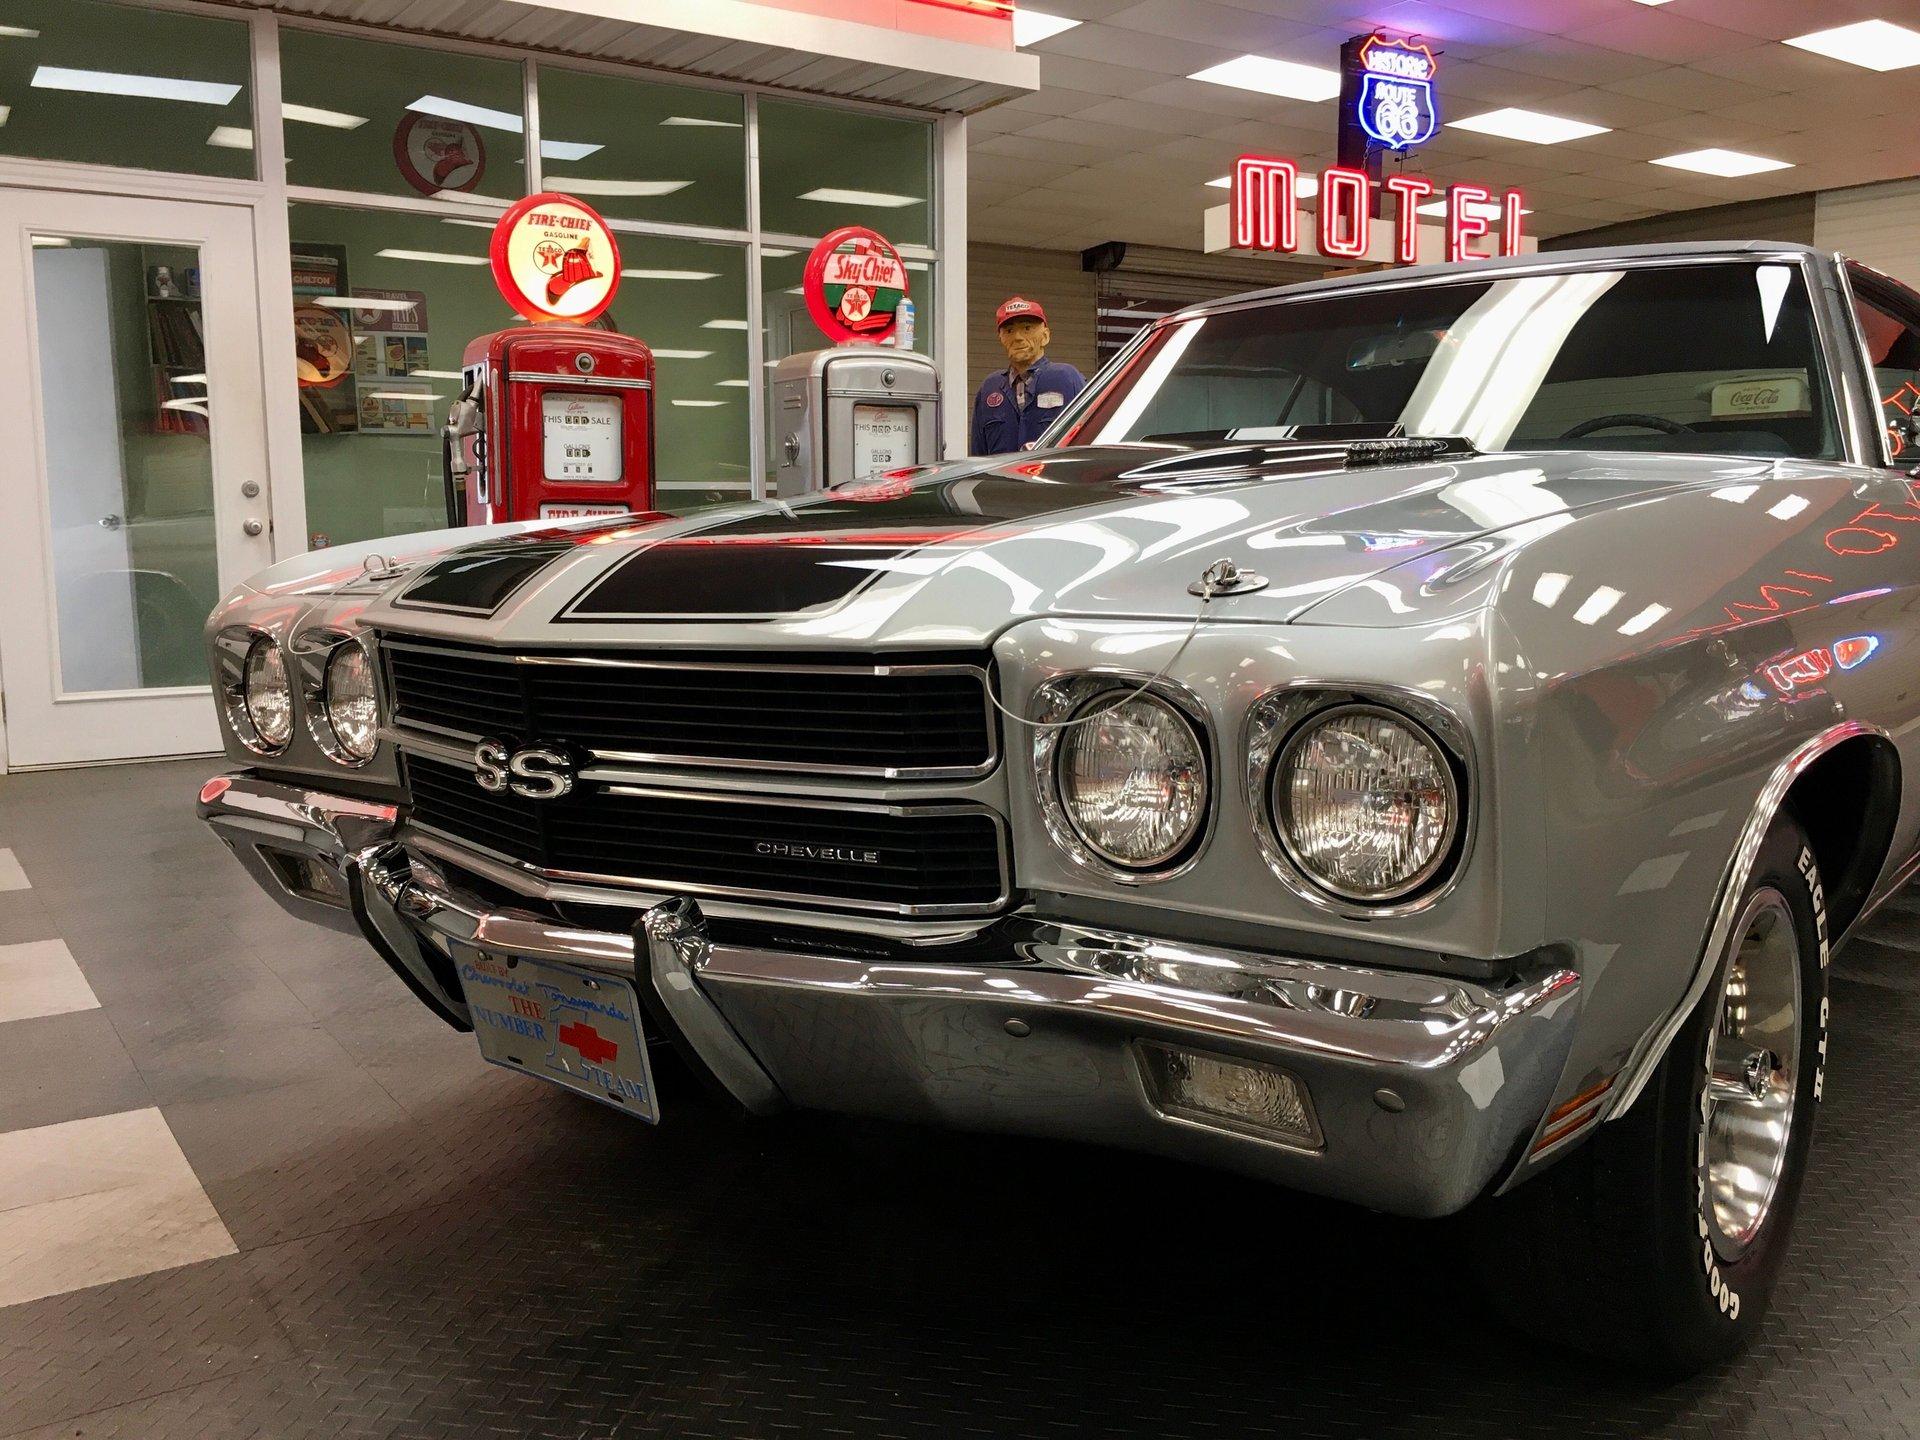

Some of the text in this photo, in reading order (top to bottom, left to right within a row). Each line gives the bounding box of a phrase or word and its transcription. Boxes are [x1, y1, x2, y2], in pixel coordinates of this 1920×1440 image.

[1374, 81, 1417, 103] ROUTE
[1375, 100, 1419, 139] 66
[527, 213, 592, 231] FIRE-CHIEF
[543, 231, 578, 240] GASOLINE
[834, 254, 896, 283] Sky Chief
[591, 417, 611, 426] SALE
[854, 423, 871, 431] THIS
[893, 425, 909, 433] SALE
[475, 742, 572, 799] SS
[755, 841, 878, 864] CHEVELLE
[1798, 845, 1830, 970] EAGLE
[508, 994, 546, 1021] THE
[473, 1005, 548, 1042] NUMBER
[590, 1064, 647, 1104] TEAM
